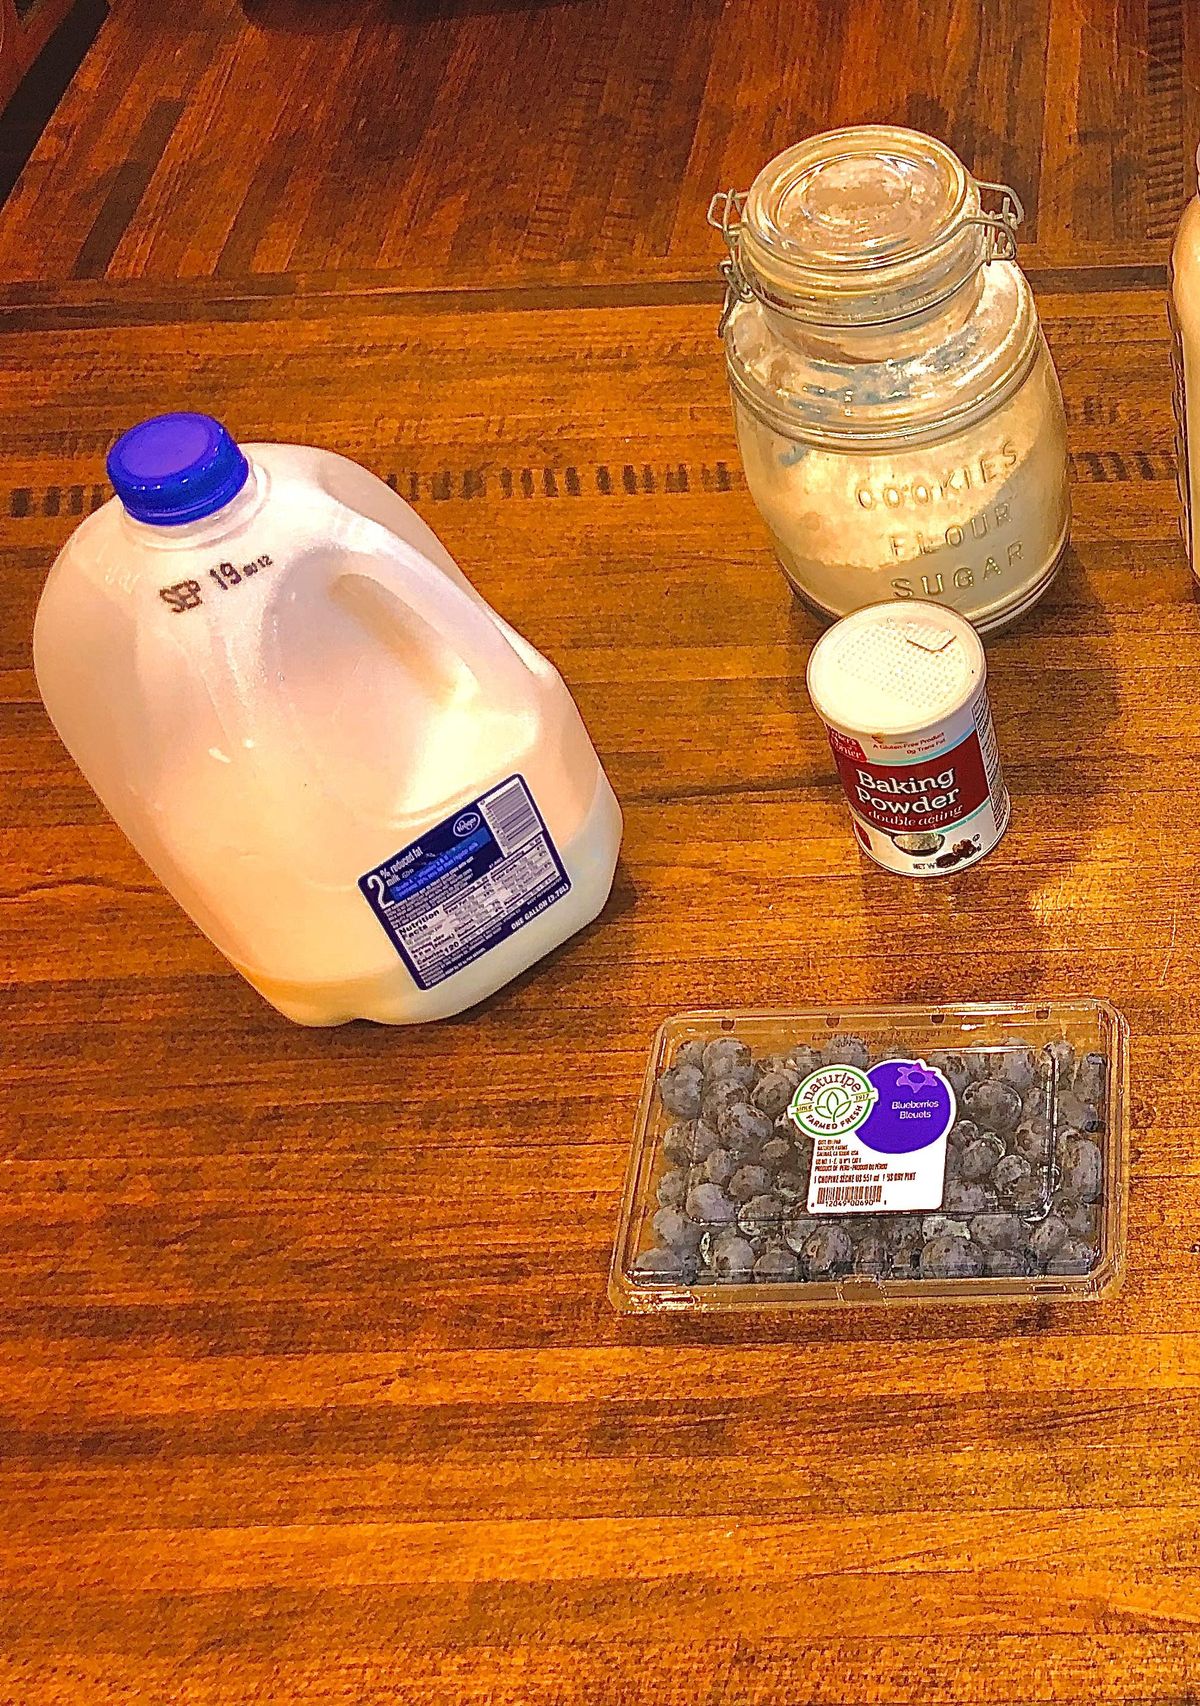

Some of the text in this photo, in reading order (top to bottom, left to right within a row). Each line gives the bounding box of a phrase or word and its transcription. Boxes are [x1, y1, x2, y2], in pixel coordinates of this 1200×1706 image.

[890, 502, 1013, 557] FLOUR
[890, 541, 1024, 599] SUGAR
[160, 579, 202, 613] SEP
[209, 562, 242, 590] 19
[920, 732, 944, 744] Product
[856, 768, 954, 794] Baking
[855, 785, 960, 814] Powder
[868, 804, 963, 826] double acting
[367, 874, 395, 909] 2
[390, 851, 416, 874] reduced
[412, 846, 424, 858] fat
[386, 874, 401, 886] milk
[400, 908, 440, 935] Nutrition
[511, 916, 525, 930] ONE
[524, 900, 549, 922] GALLON
[402, 924, 428, 942] Facts
[416, 942, 460, 967] Calories 120
[803, 1072, 862, 1102] naturipe
[806, 1105, 863, 1130] FARMED FRESH
[892, 1100, 939, 1110] Blueberries
[900, 1111, 931, 1119] Bleuets
